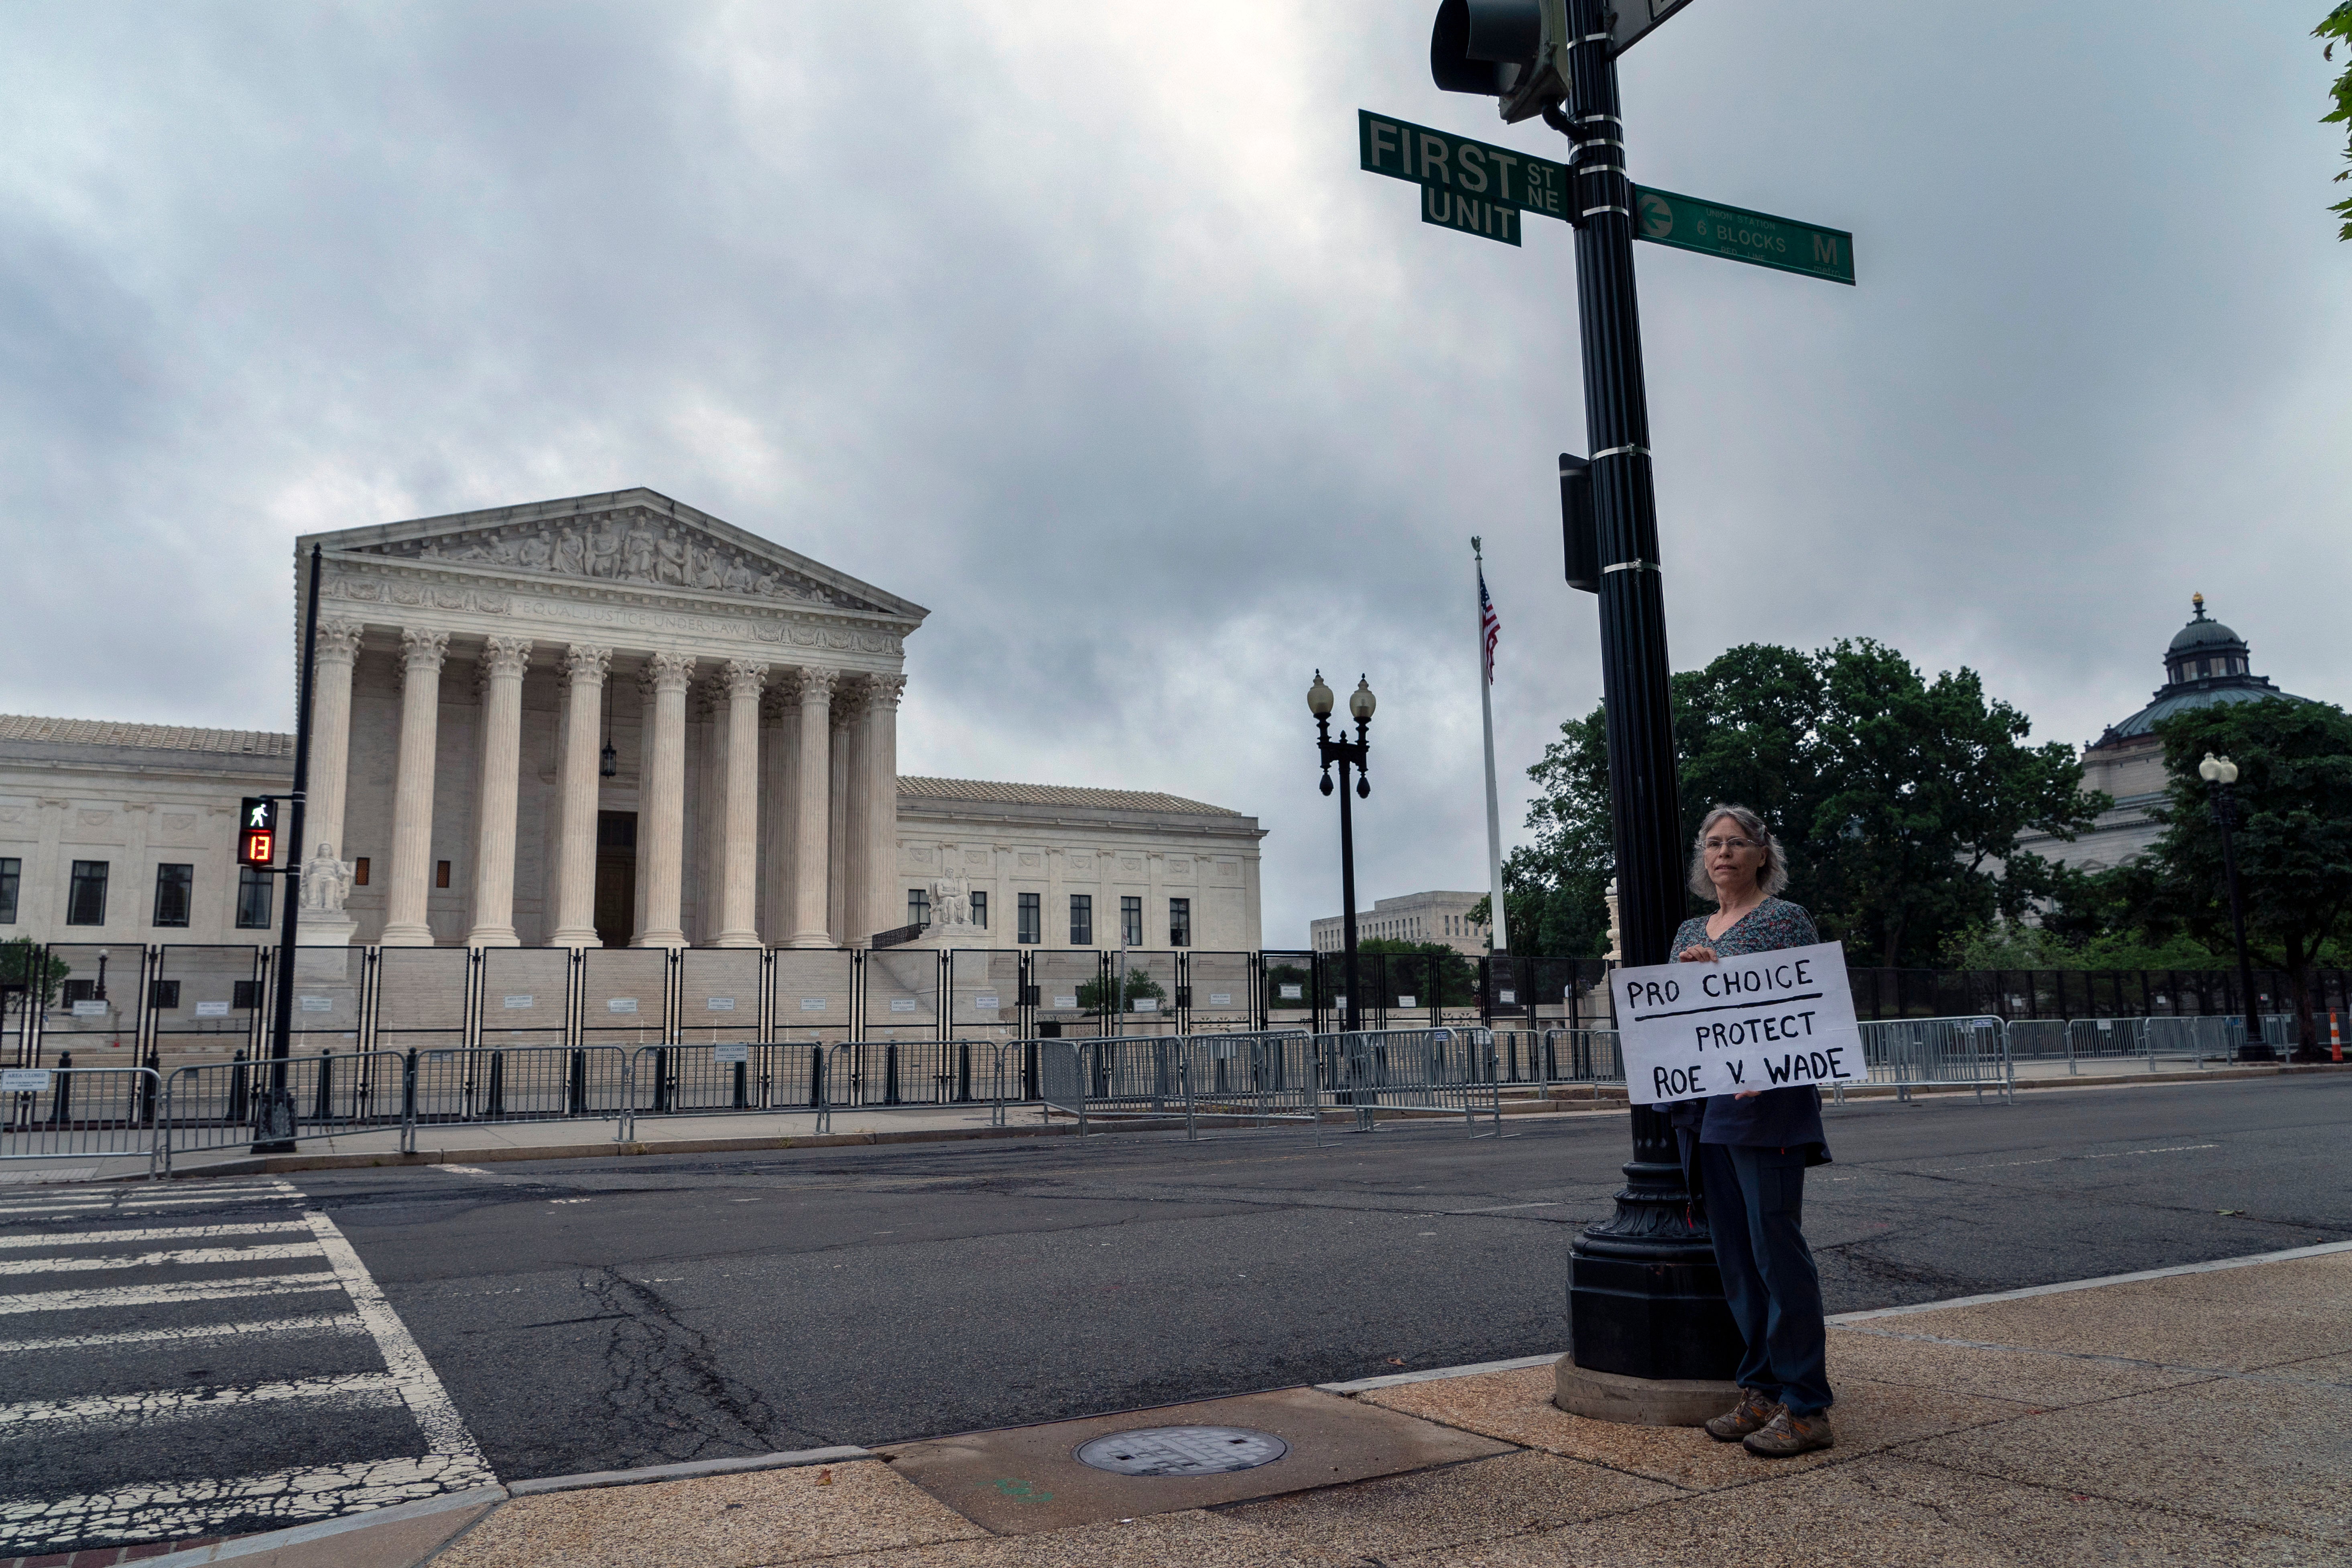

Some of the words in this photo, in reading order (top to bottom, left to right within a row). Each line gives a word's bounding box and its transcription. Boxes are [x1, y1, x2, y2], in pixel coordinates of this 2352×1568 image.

[1370, 120, 1517, 200] FIRST
[1527, 163, 1554, 188] ST
[1429, 187, 1514, 239] UNIT
[1528, 185, 1559, 213] NE
[1706, 208, 1732, 221] UNION
[1737, 217, 1776, 230] STATION
[1697, 220, 1707, 236] 6
[1717, 224, 1786, 252] BLOCKS
[1813, 234, 1838, 266] M
[1721, 246, 1738, 256] RED
[1747, 252, 1766, 262] LINE
[1813, 265, 1840, 277] metro
[523, 602, 579, 618] EQUAL
[582, 607, 646, 625] JUSTICE
[654, 614, 705, 630] UNDER
[712, 619, 742, 635] LAW
[249, 835, 271, 861] 13
[1627, 980, 1680, 1009] PRO
[1702, 959, 1813, 997] CHOICE
[1695, 1011, 1815, 1052] PROTECT
[1653, 1065, 1706, 1099] ROE
[1726, 1059, 1745, 1084] V.
[1763, 1047, 1851, 1085] WADE
